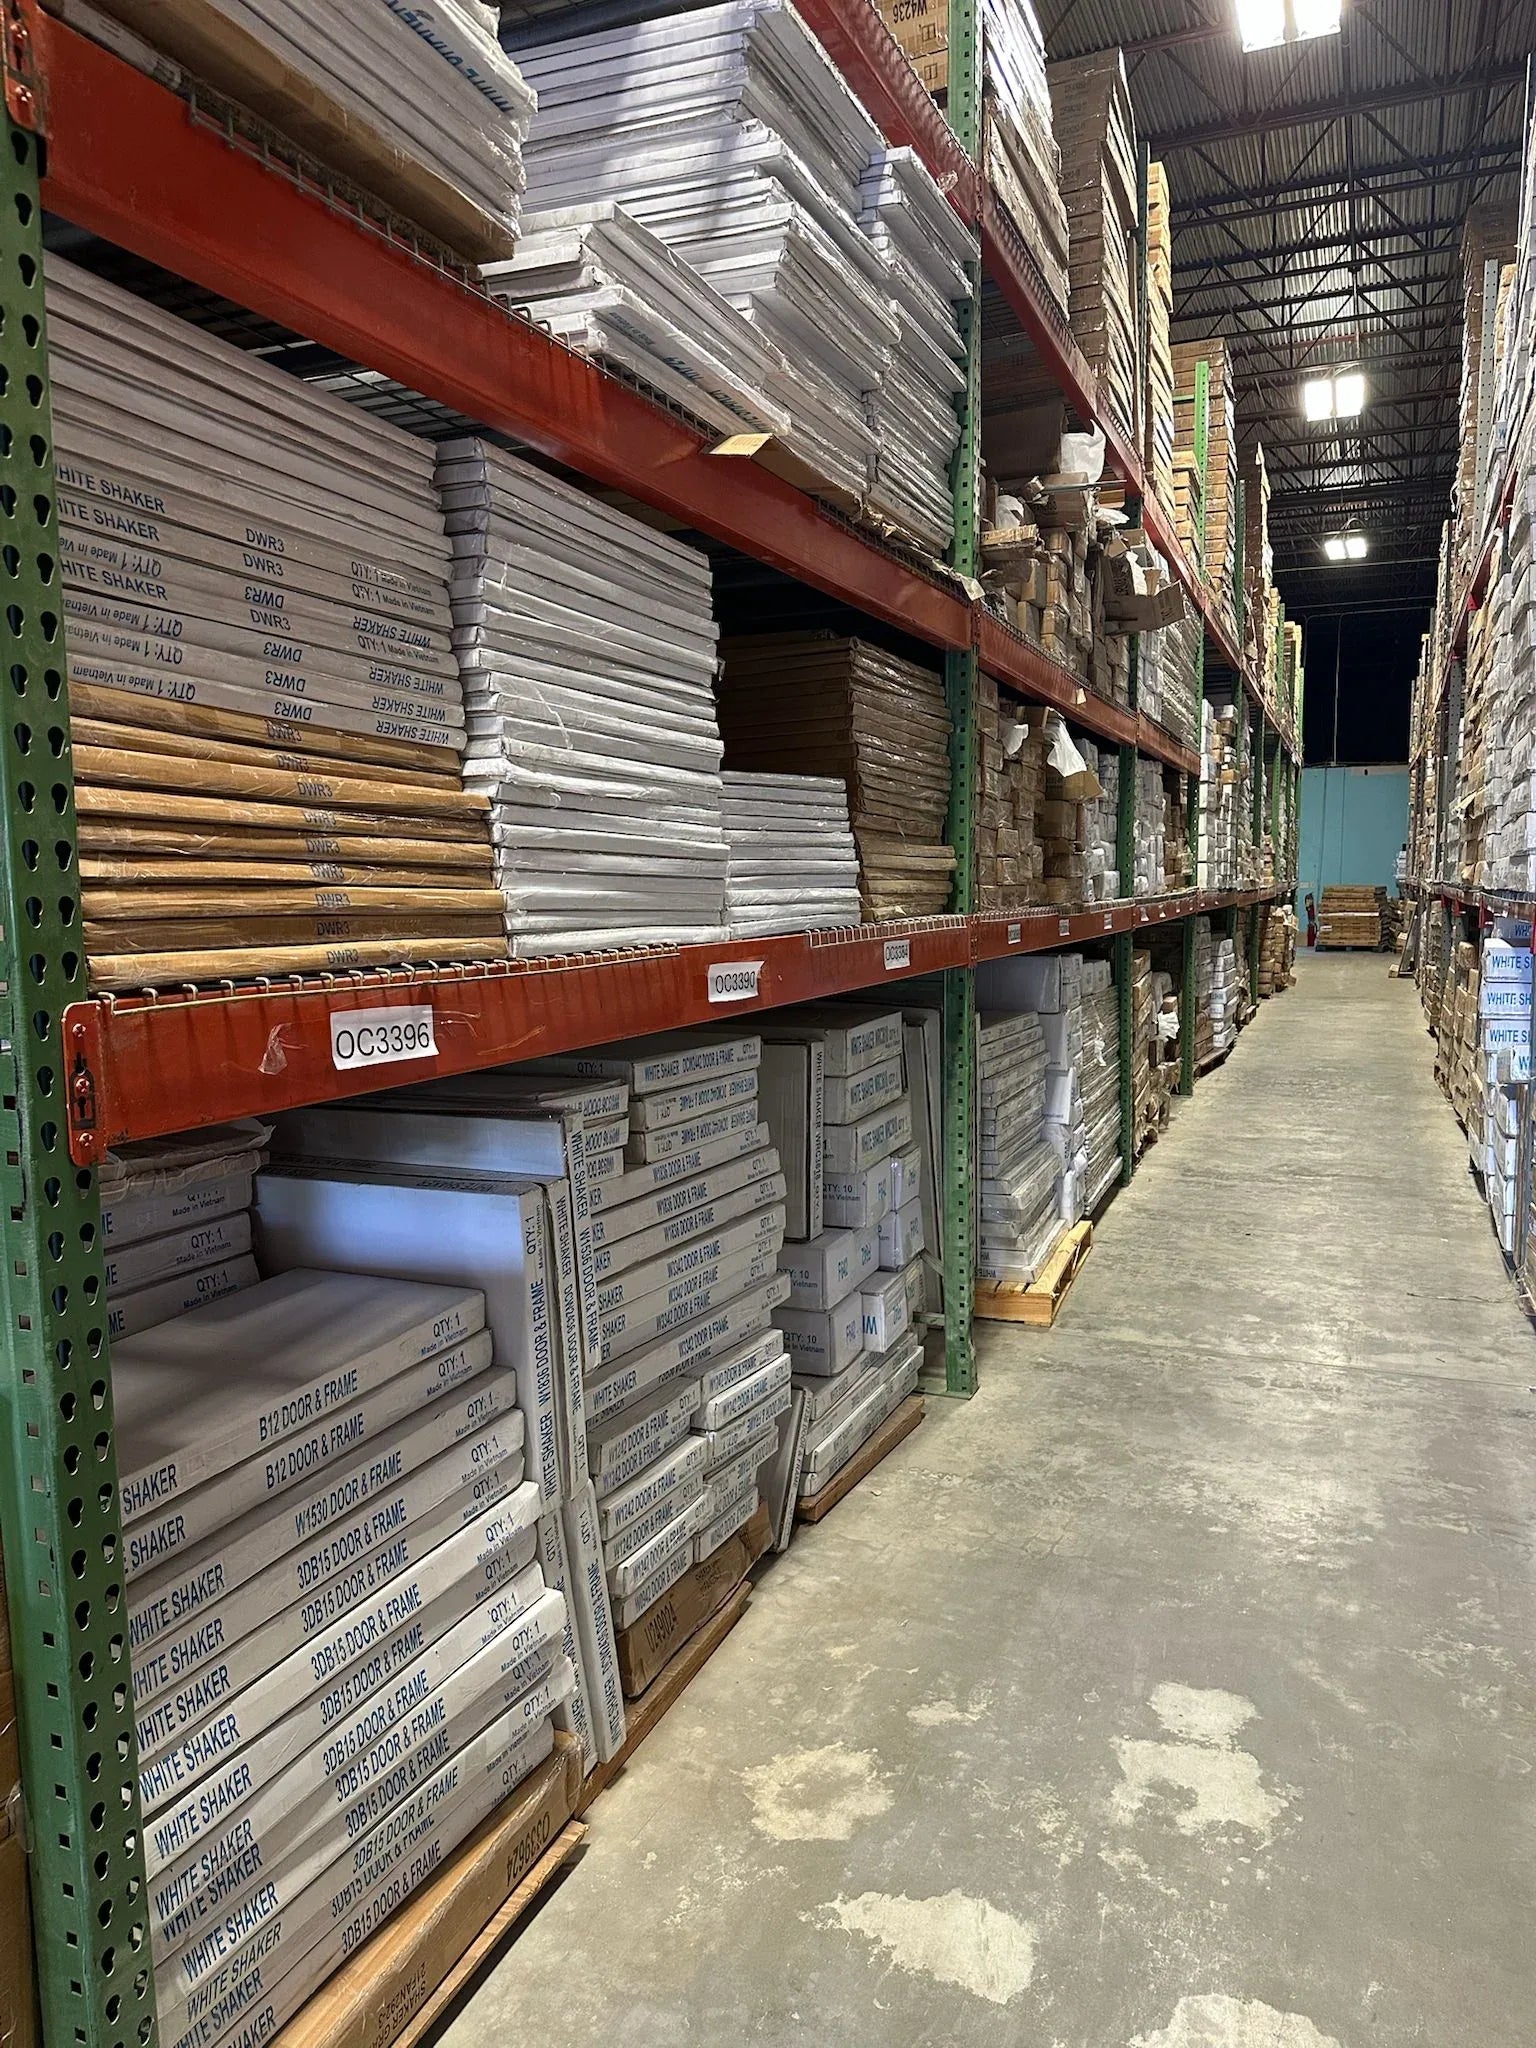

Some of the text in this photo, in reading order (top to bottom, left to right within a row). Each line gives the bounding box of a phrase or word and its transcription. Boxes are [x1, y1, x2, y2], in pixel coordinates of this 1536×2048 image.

[56, 463, 165, 513] HITE SHAKER
[94, 509, 160, 541] SHAKER
[246, 528, 284, 552] DWR3
[132, 555, 161, 577] QTY:
[243, 553, 283, 576] DWR3
[60, 558, 168, 600] HITE SHAKER
[63, 599, 140, 625] Made Vietna
[244, 587, 284, 609] DWR3
[250, 609, 290, 631] DWR3
[353, 616, 431, 648] WHITE SHAKER
[114, 636, 140, 651] Made
[263, 641, 302, 663] DWR3
[73, 666, 113, 683] Vietnam
[128, 675, 154, 690] Made
[265, 670, 306, 692] DWR3
[369, 666, 444, 695] WHITE SHAKER
[169, 682, 196, 700] QTY:
[274, 702, 312, 721] DWR3
[373, 696, 445, 721] WHITE SHAKER
[376, 720, 449, 744] WHITE SHAKER
[306, 839, 340, 854] DWR3
[317, 921, 350, 936] DWR3
[327, 950, 359, 964] DWR3
[1492, 956, 1521, 969] WHITE
[716, 971, 756, 994] OC3390
[1487, 992, 1516, 1006] WHITE
[335, 1022, 431, 1060] OC3396
[1489, 1030, 1518, 1042] WHITE
[578, 1062, 597, 1073] QTY:
[644, 1059, 680, 1082] WHITE SHAKER
[843, 1185, 852, 1193] 10
[557, 1196, 569, 1231] WHITE
[191, 1231, 214, 1249] QTY:
[572, 1131, 599, 1353] WHITE SHAKER W1536 FRAME
[559, 1231, 572, 1280] SHAKER
[196, 1276, 220, 1293] QTY:
[792, 1280, 818, 1288] Vietnam
[800, 1270, 809, 1279] 10
[433, 1312, 461, 1338] QTY: 1
[602, 1314, 626, 1342] SHAKER
[438, 1351, 465, 1378] QTY: 1
[531, 1278, 558, 1502] WHITE SHAKER W1836 FRAME
[571, 1381, 582, 1416] FRAME
[593, 1370, 637, 1410] WHITE SHAKER
[259, 1368, 358, 1442] B12 DOOR FRAME
[467, 1392, 493, 1419] QTY: 1
[266, 1412, 364, 1489] B12 DOOR FRAME
[471, 1435, 499, 1463] QTY: 1
[122, 1463, 178, 1515] SHAKER
[295, 1451, 402, 1538] W1530 DOOR & FRAME
[473, 1472, 500, 1500] QTY: 1
[130, 1515, 186, 1569] SHAKER
[297, 1499, 407, 1590] 3DB15 DOOR & FRAME
[486, 1519, 506, 1543] QTY:
[485, 1556, 506, 1580] QTY:
[302, 1538, 409, 1633] 3DB15 DOOR & FRAME
[129, 1564, 225, 1648] WHITE SHAKER
[311, 1583, 422, 1681] 3DB15 DOOR & FRAME
[512, 1626, 534, 1651] QTY:
[171, 1618, 225, 1675] SHAKER
[320, 1622, 424, 1725] 3DB15 DOOR FRAME
[511, 1656, 534, 1681] QTY:
[177, 1664, 231, 1723] SHAKER
[524, 1692, 544, 1717] QTY:
[323, 1669, 430, 1776] 3DB15 DOOR FRAME
[139, 1713, 240, 1804] WHITE SHAKER
[335, 1697, 446, 1803] 3DB15 DOOR FRAME
[345, 1728, 450, 1838] 3DB15 DOOR FRAME
[154, 1762, 252, 1860] WHITE SHAKER
[352, 1766, 459, 1874] 3DB15 DOOR FRAME
[155, 1818, 253, 1921] WHITE SHAKER
[209, 1843, 263, 1905] SHAKER
[342, 1839, 442, 1955] 3DB15 FRAME
[181, 1925, 227, 1983] WHITE
[226, 1881, 279, 1945] SHAKER
[187, 1922, 282, 2023] WHITE SHAKER
[210, 1967, 264, 2030] SHAKER
